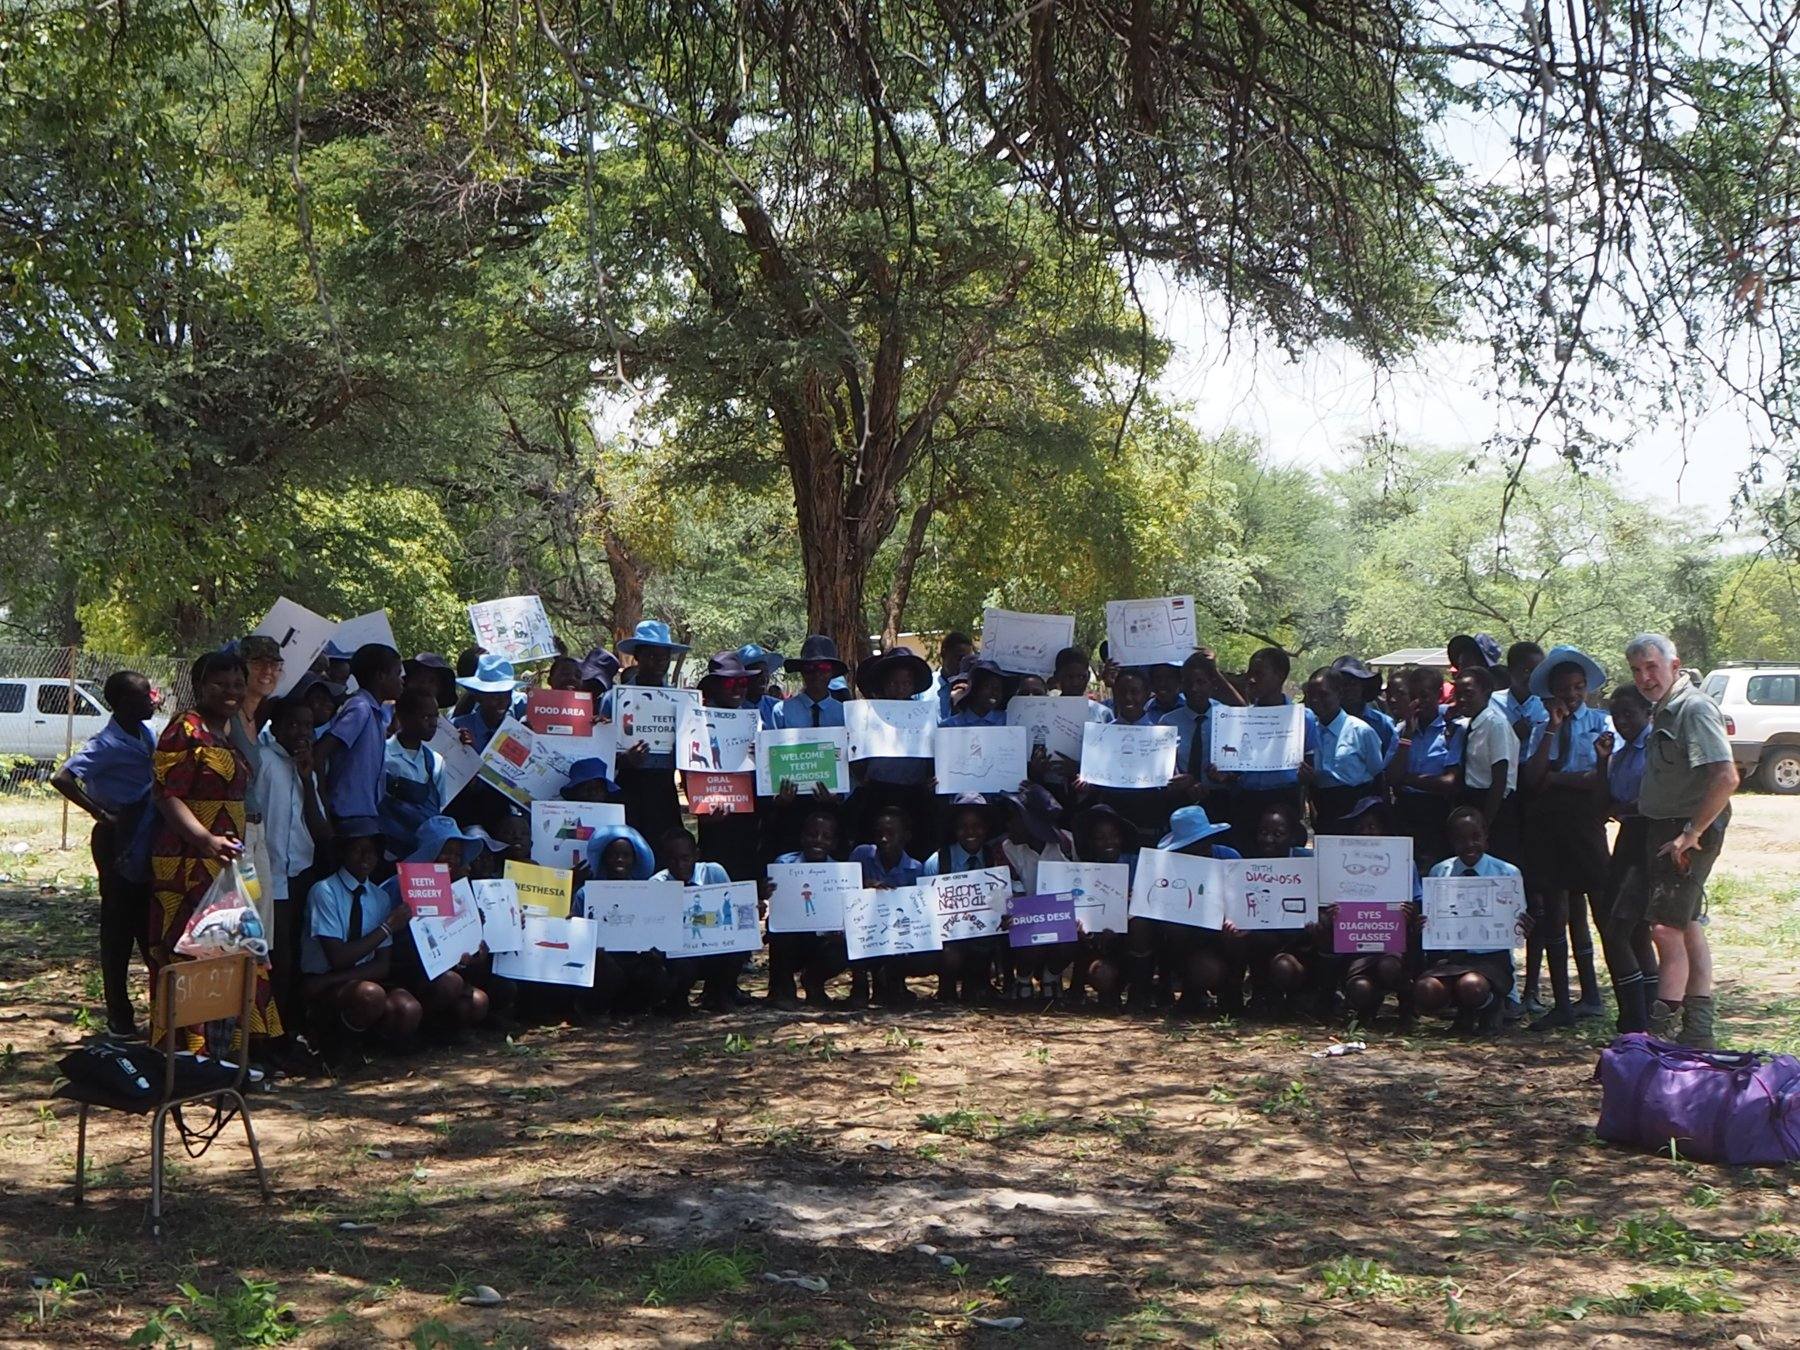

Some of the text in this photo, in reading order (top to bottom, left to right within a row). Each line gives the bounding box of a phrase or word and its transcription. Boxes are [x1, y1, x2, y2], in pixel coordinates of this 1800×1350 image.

[534, 706, 585, 716] FOOD AREA
[780, 751, 825, 761] WELCOME
[790, 762, 817, 771] TEETH
[707, 776, 731, 784] ORAL
[779, 771, 830, 781] DIAGNOSIS
[706, 785, 734, 793] HEALT
[692, 795, 749, 803] PREVENTION
[411, 878, 435, 886] TEETH
[408, 889, 442, 898] SURGERY
[1013, 912, 1071, 926] DRUGS DESK
[1357, 911, 1381, 919] EYES
[1339, 922, 1399, 931] DIAGNOSIS/
[1348, 933, 1391, 941] GLASSES
